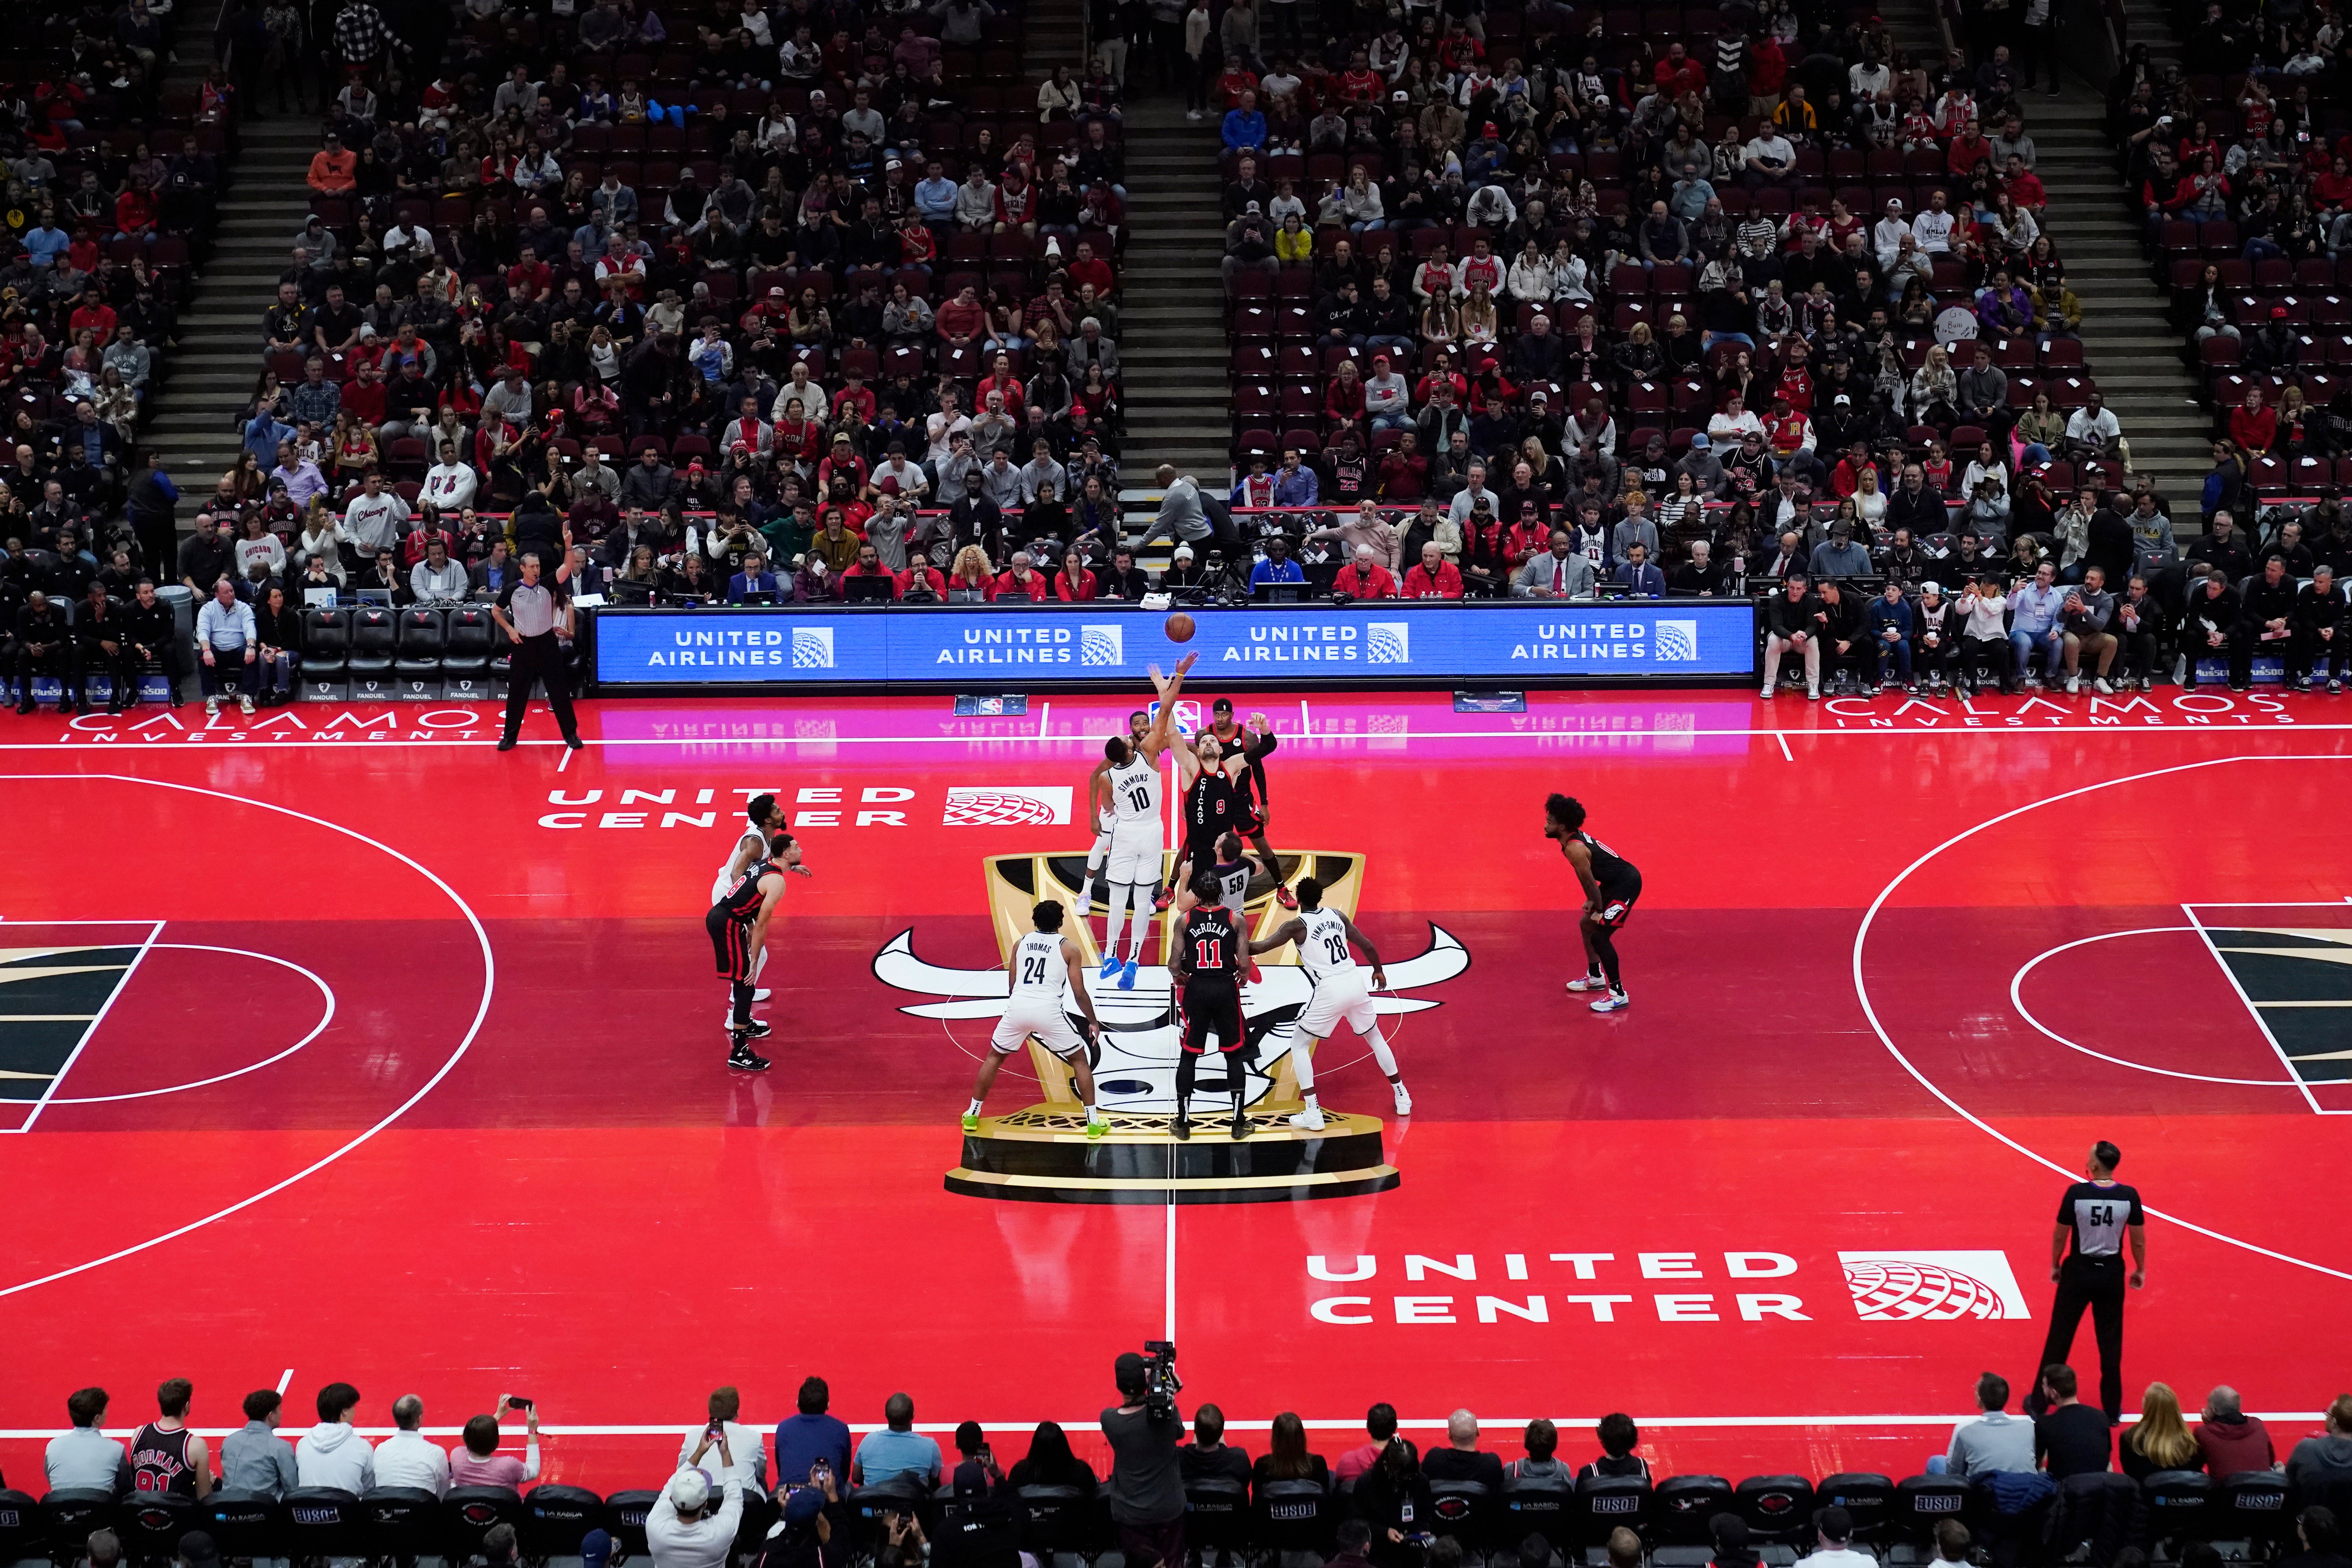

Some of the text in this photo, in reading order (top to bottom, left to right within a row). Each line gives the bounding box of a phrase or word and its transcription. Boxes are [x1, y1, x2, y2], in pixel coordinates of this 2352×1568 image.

[1580, 80, 1604, 90] BULLS
[1955, 122, 1963, 134] 6
[1469, 269, 1494, 283] BULLS
[1949, 309, 1962, 318] Go
[1784, 372, 1804, 382] Chicago
[1798, 383, 1805, 394] 6
[2327, 415, 2352, 432] BULL
[299, 448, 314, 460] ULLS
[1336, 466, 1362, 481] BULLS
[1733, 467, 1757, 480] BULLS
[1340, 479, 1358, 491] 23
[211, 510, 240, 523] CHICAGO
[358, 506, 387, 522] Chicago
[268, 520, 297, 534] CHICAGO
[245, 545, 271, 558] CHICAGO
[1582, 541, 1603, 550] CHICAGO
[729, 552, 739, 566] 5
[1589, 549, 1599, 560] 11
[676, 631, 782, 646] UNITED
[964, 628, 1071, 644] UNITED
[1250, 626, 1357, 642] UNITED
[1539, 624, 1645, 639] UNITED
[648, 650, 782, 666] AIRLINES
[936, 648, 1071, 663] AIRLINES
[1223, 646, 1357, 661] AIRLINES
[1511, 643, 1645, 659] AIRLINES
[1825, 694, 2285, 716] CALAMOS
[1837, 715, 2294, 727] INVESTMENTS
[59, 730, 506, 742] INVESTMENT
[1118, 773, 1149, 793] SIMMONS
[548, 788, 915, 805] UNITED
[1127, 787, 1150, 812] 10
[1197, 778, 1208, 825] CHICAGO
[1216, 799, 1225, 815] 9
[726, 874, 747, 899] 8
[1228, 874, 1244, 895] 58
[1189, 921, 1229, 938] DeROZAN
[1310, 921, 1343, 941] FINNEY-SMITH
[1026, 942, 1052, 954] THOMAS
[1196, 939, 1223, 969] 11
[1324, 934, 1348, 965] 28
[1023, 956, 1047, 985] 24
[2090, 1205, 2114, 1227] 54
[1306, 1252, 1798, 1282] UNITED
[1310, 1294, 1813, 1324] CENTER
[133, 1449, 183, 1478] RODMAN
[135, 1468, 170, 1491] 91
[1602, 1499, 1629, 1511] USO
[1924, 1497, 1951, 1509] USO
[2245, 1494, 2274, 1507] USO
[1280, 1504, 1307, 1516] USO
